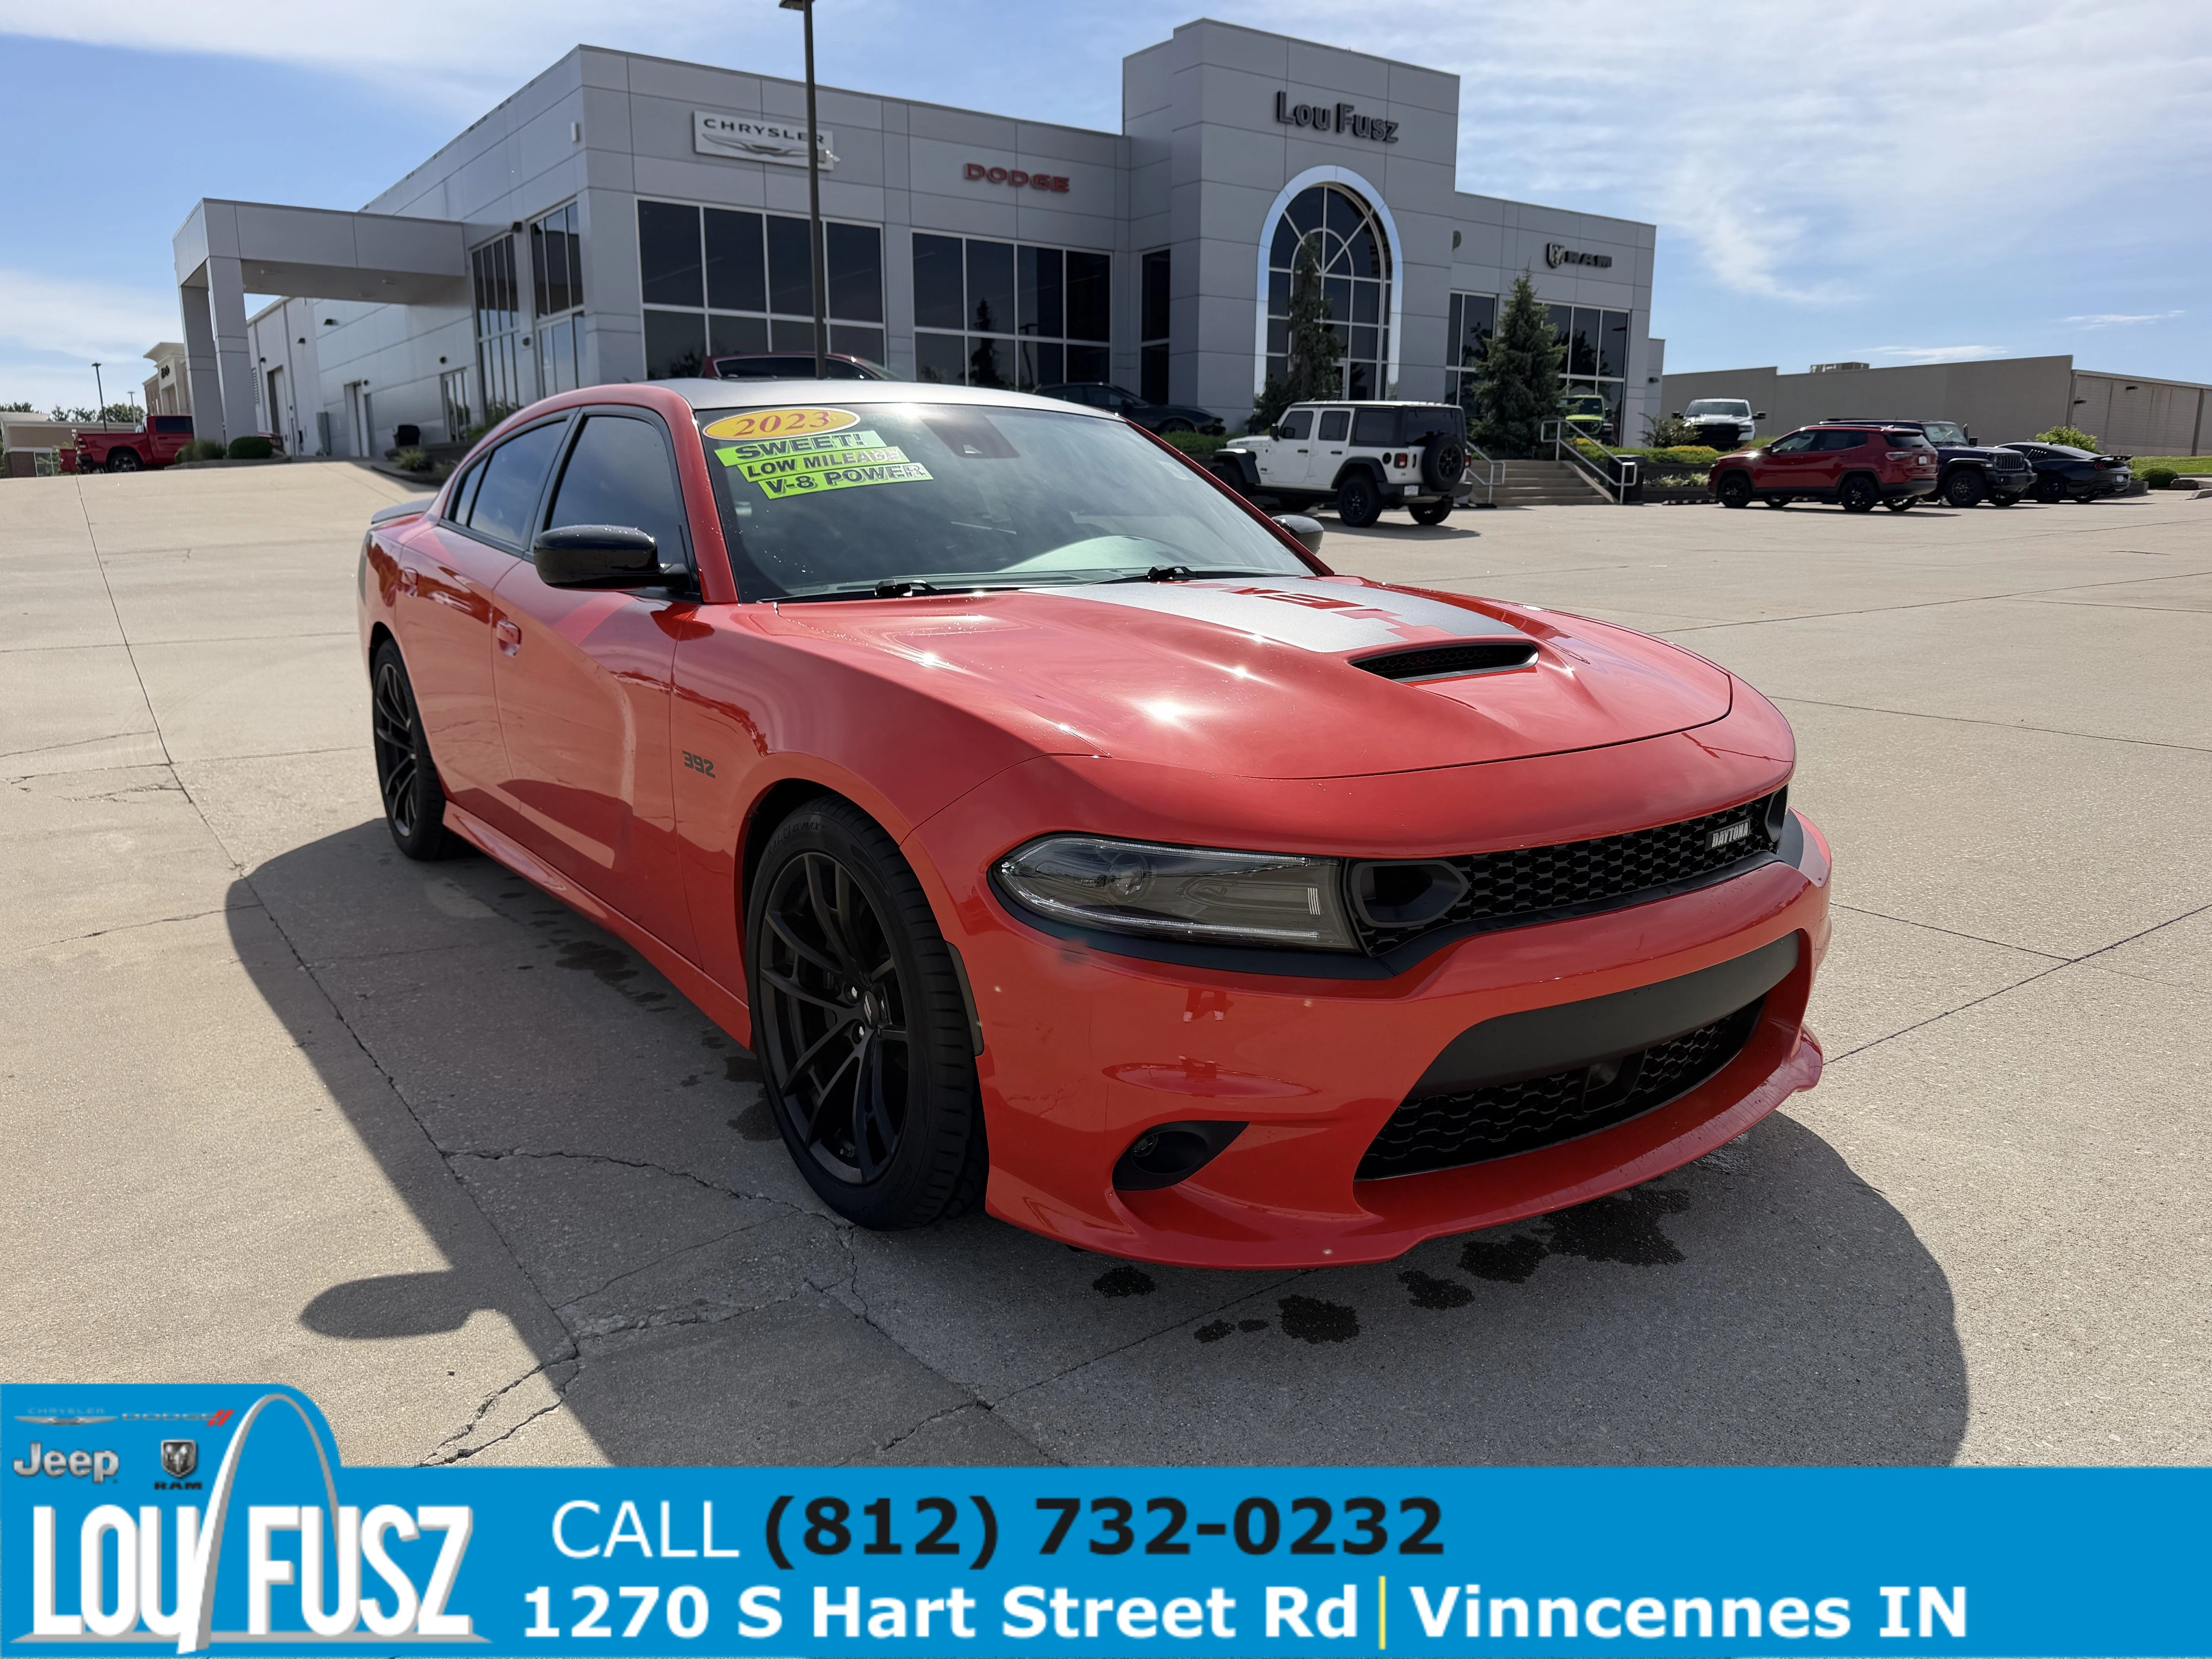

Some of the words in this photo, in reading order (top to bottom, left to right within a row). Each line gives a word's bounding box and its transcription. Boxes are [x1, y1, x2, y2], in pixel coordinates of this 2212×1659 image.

[1276, 90, 1331, 131] Lou
[1336, 102, 1399, 143] Fusz
[703, 118, 824, 144] CHRYSLER
[963, 163, 1070, 194] DODGE
[1565, 251, 1612, 268] RAM
[733, 411, 830, 437] 2023
[735, 433, 865, 460] SWEET!
[746, 459, 797, 478] LOW
[804, 448, 902, 469] MILEAGE
[765, 476, 819, 495] V-8
[823, 463, 926, 486] POWER
[682, 750, 716, 779] 392
[1711, 822, 1749, 848] DAYTONA
